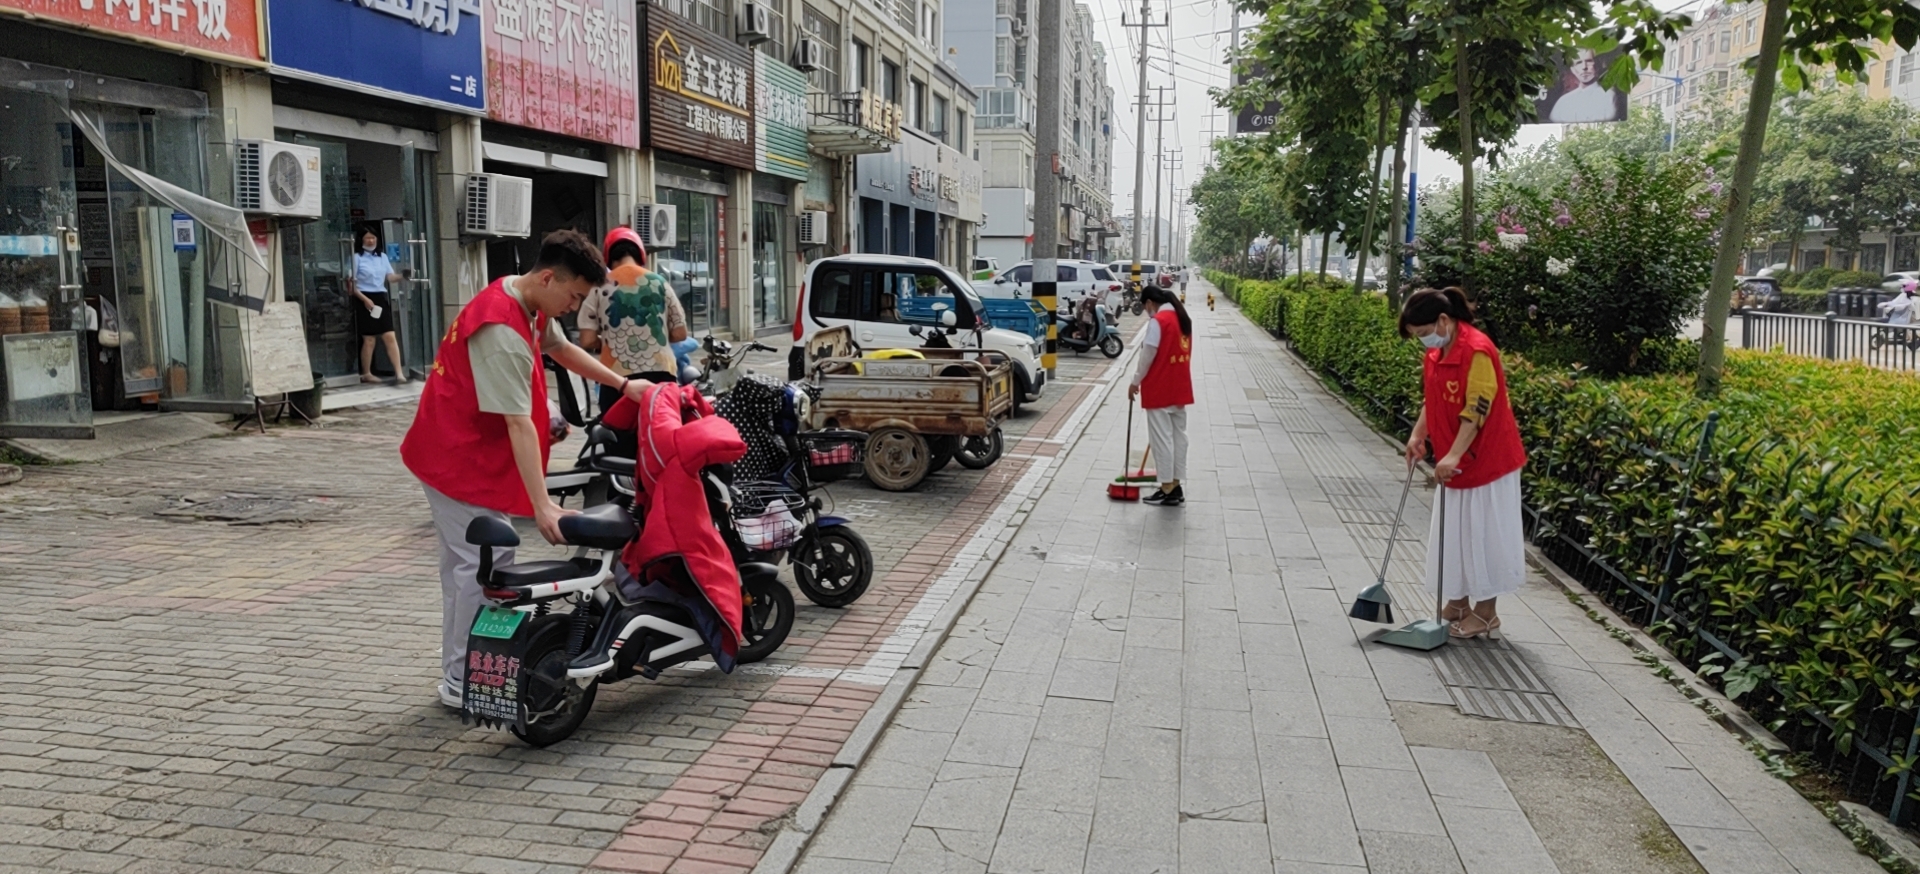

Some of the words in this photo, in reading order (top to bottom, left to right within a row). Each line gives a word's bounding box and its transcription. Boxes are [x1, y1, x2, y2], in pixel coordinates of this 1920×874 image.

[449, 74, 477, 98] 二店
[685, 45, 747, 110] 金玉装潢
[685, 104, 748, 145] 工程设计有限公司
